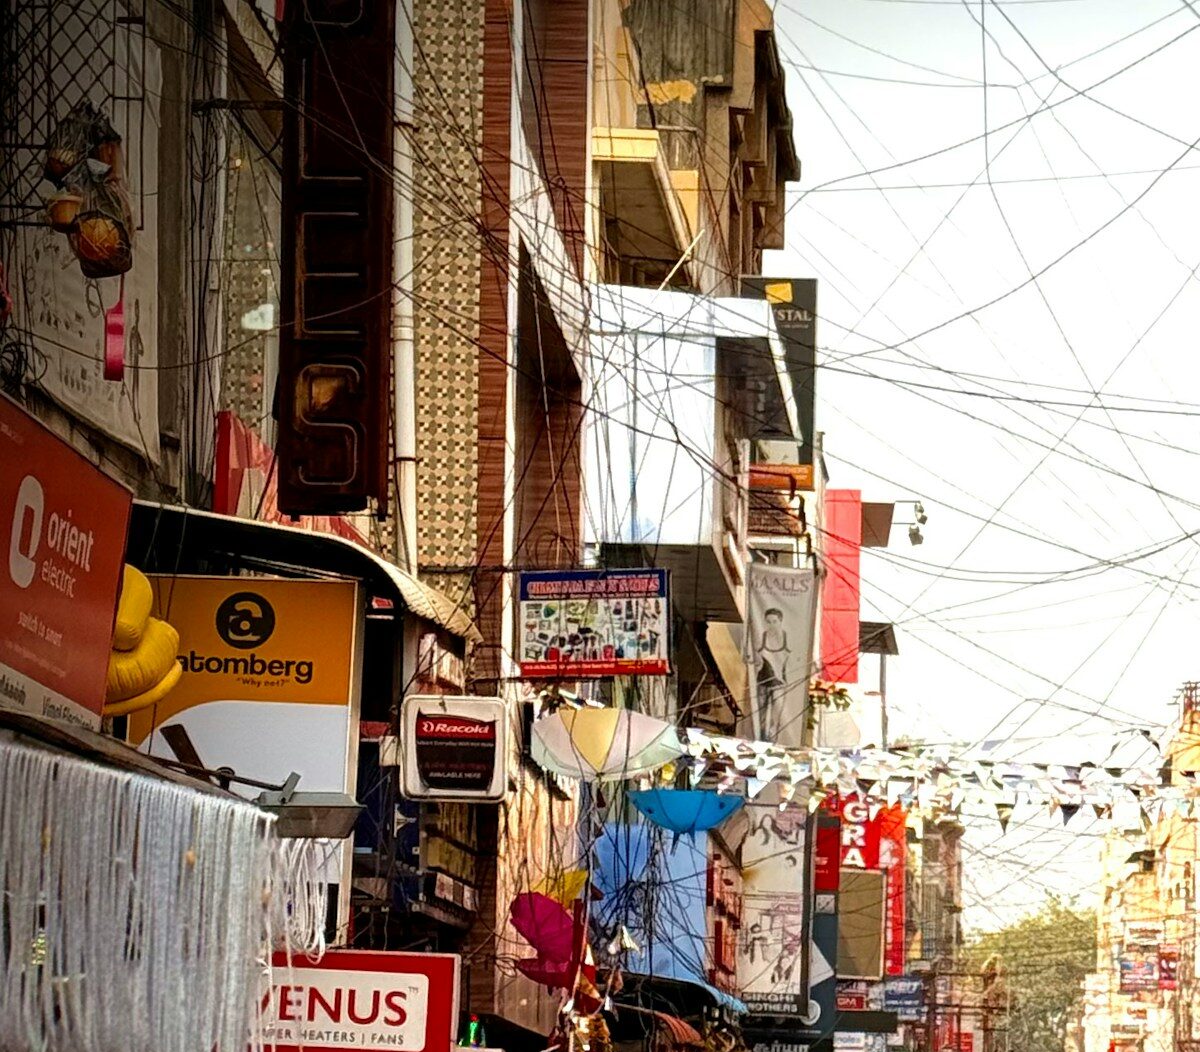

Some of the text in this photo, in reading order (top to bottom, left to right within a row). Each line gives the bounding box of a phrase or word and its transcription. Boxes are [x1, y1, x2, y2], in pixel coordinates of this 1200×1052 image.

[774, 309, 812, 322] STAL
[47, 509, 94, 573] orient
[42, 558, 77, 599] electric
[435, 723, 490, 734] Racold
[371, 1032, 404, 1045] FANS
